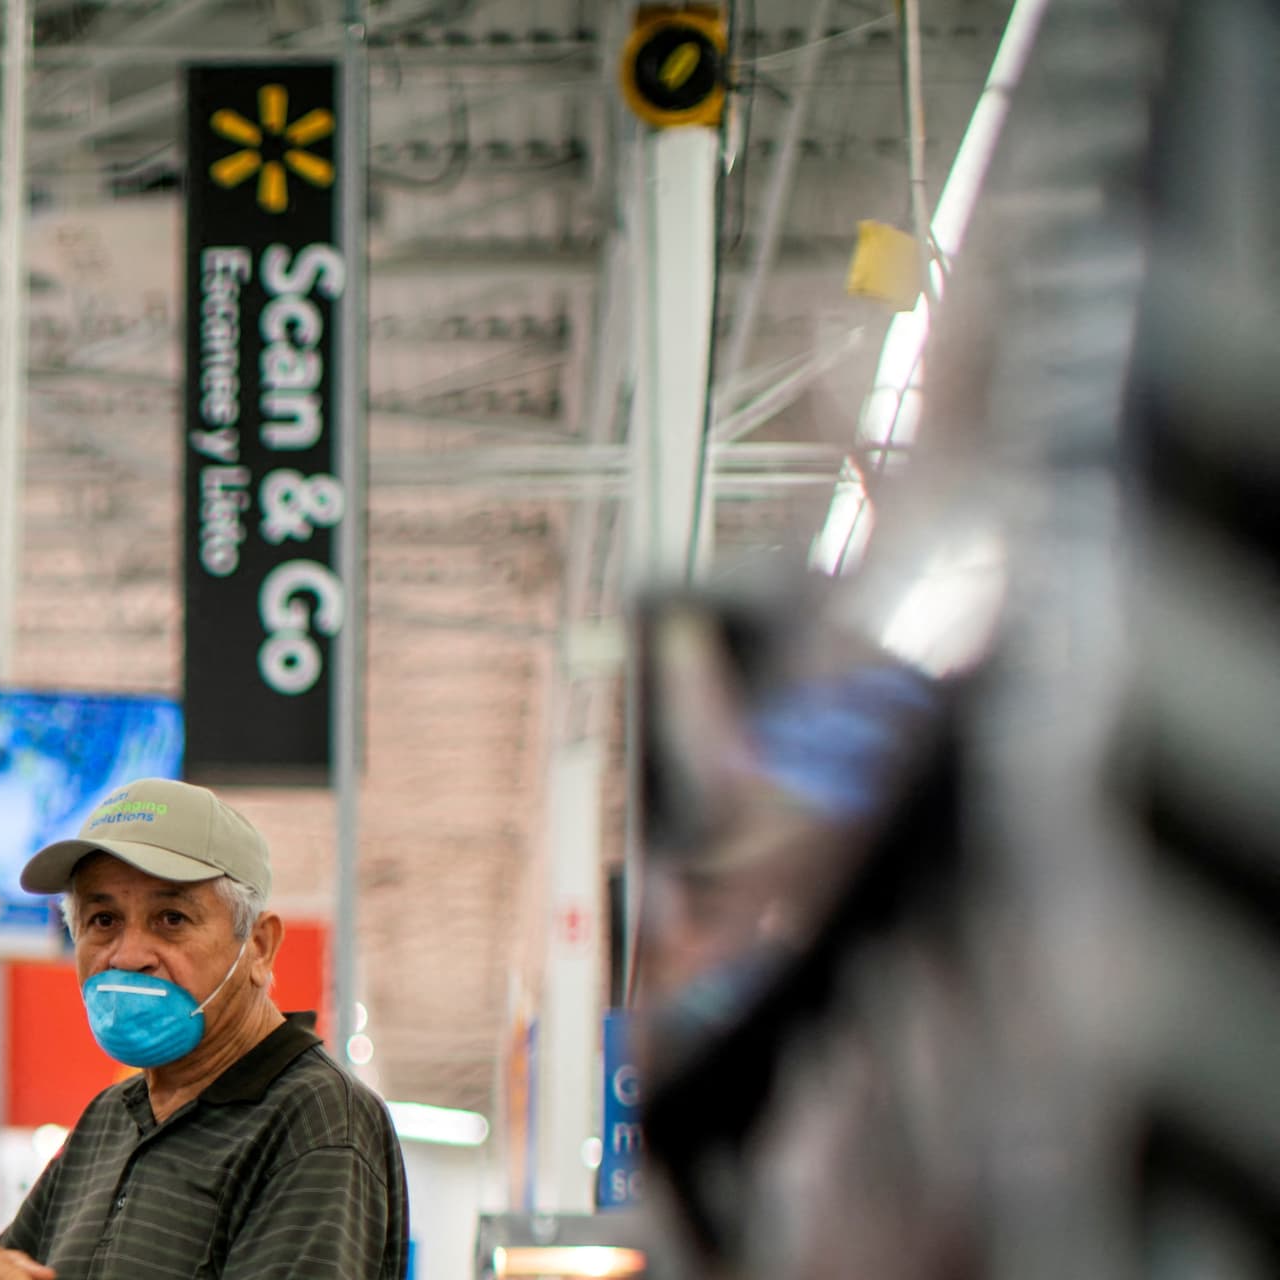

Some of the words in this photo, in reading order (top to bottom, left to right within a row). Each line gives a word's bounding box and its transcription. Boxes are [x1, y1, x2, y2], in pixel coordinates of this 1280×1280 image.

[259, 243, 345, 450] Scan
[259, 468, 345, 544] &
[258, 559, 343, 695] Go
